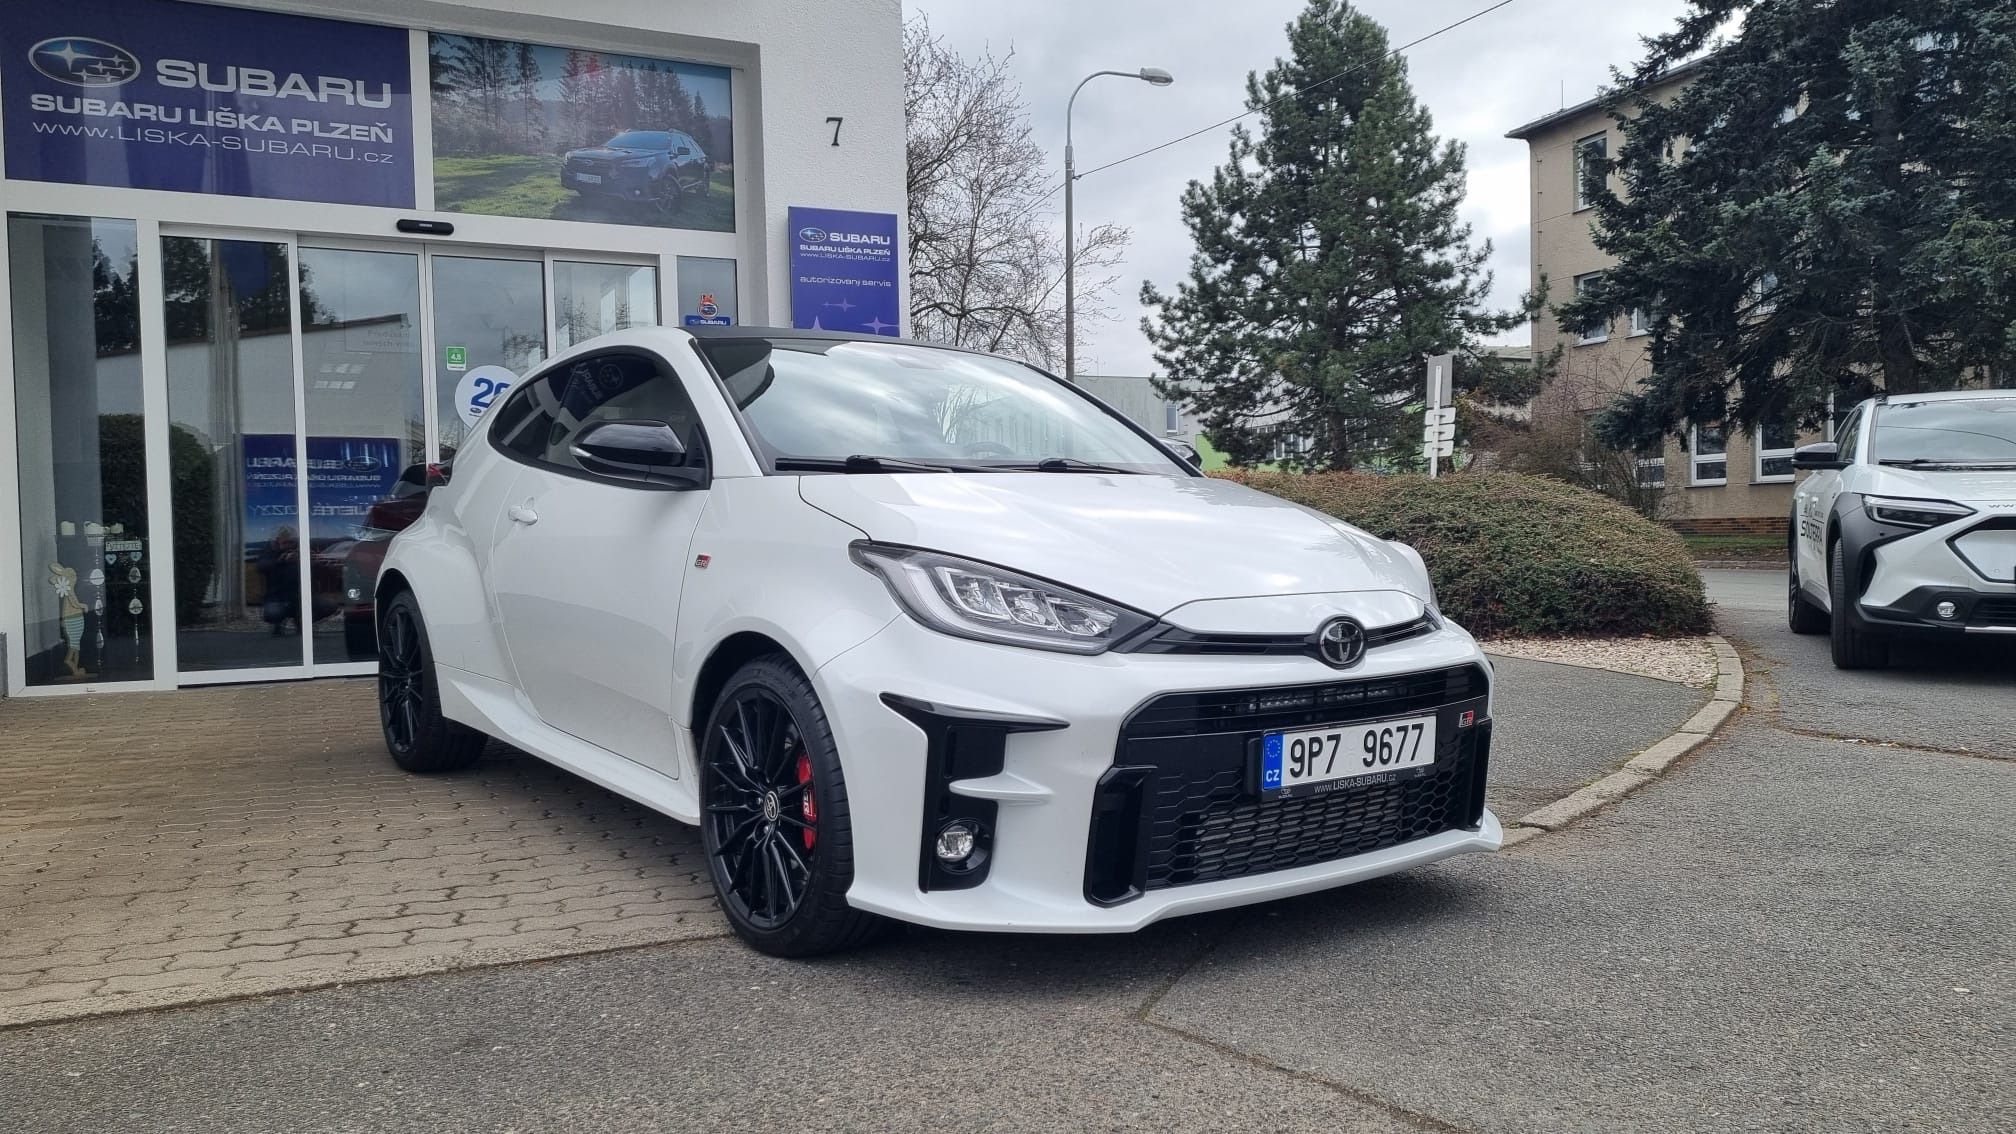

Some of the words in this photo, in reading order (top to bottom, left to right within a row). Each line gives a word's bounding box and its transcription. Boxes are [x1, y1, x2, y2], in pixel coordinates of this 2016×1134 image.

[156, 59, 392, 109] SUBARU
[31, 93, 182, 123] SUBARU
[189, 106, 286, 134] LIŠKA
[291, 121, 393, 144] PLZEŇ
[826, 117, 843, 146] 7
[32, 121, 394, 164] www.LISKA-SUBARU.cz
[800, 244, 837, 253] SUBARU
[838, 246, 862, 254] LIŠKA
[863, 248, 891, 256] PLZEŇ
[829, 232, 890, 245] SUBARU
[1289, 733, 1342, 778] 9P7
[1361, 722, 1425, 768] 9677
[1265, 769, 1280, 783] CZ
